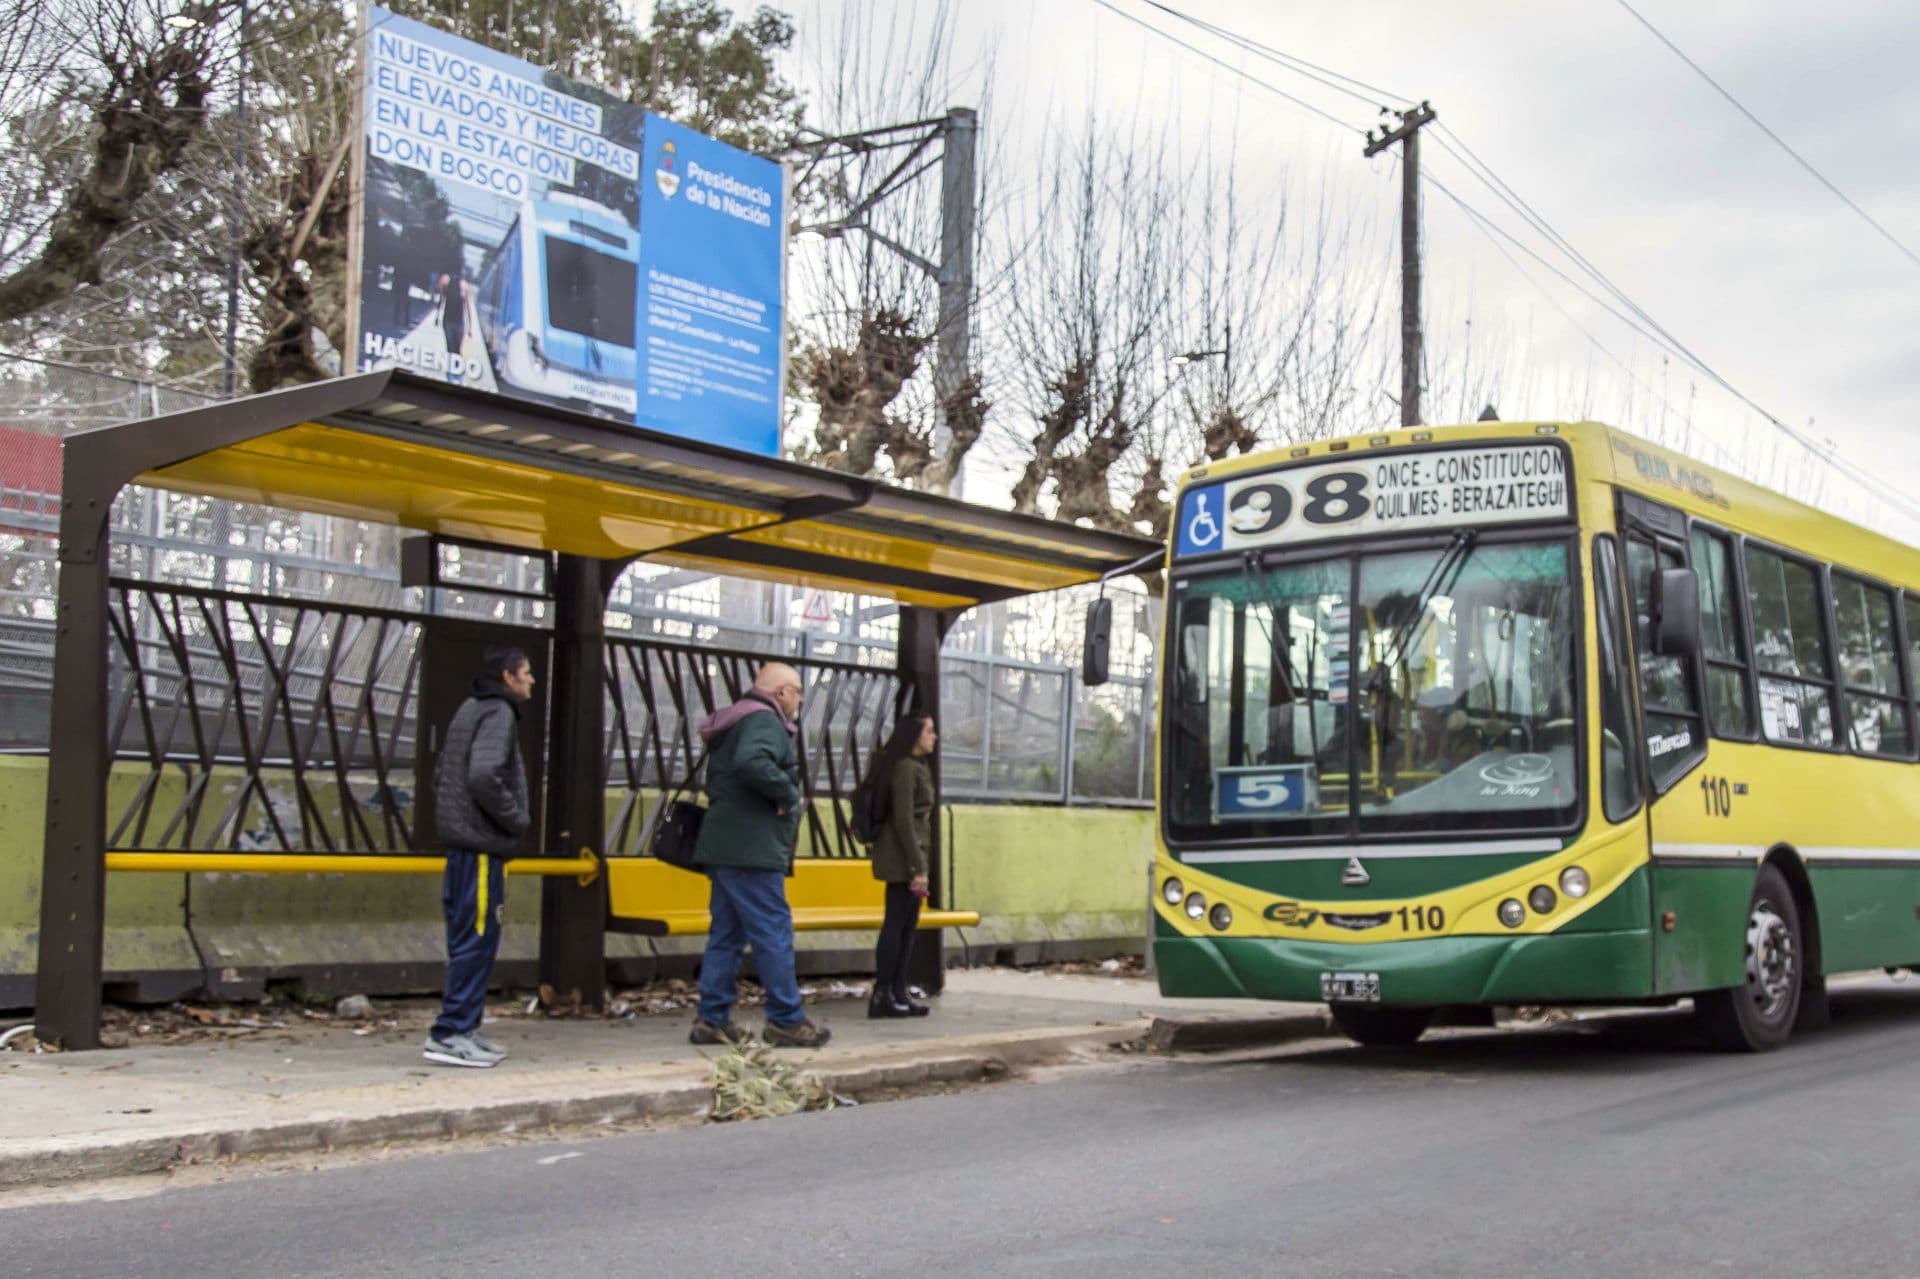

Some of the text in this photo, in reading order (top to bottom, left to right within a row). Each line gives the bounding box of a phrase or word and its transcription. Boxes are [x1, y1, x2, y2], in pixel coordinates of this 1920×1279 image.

[378, 33, 596, 129] NUEVOS ANDENES
[377, 98, 569, 181] EN LA ESTACION
[378, 65, 633, 174] ELEVADOS Y MEJORAS
[376, 131, 523, 195] DON BOSCO
[687, 160, 771, 208] Presidencia
[685, 184, 771, 228] de la Nación
[365, 332, 483, 380] HACIENDO
[1377, 461, 1420, 489] ONCE
[1436, 448, 1563, 483] CONSTITUCION
[1230, 472, 1370, 535] 98
[1376, 490, 1439, 519] QUILMES
[1452, 481, 1563, 513] BERAZATEGUI
[1236, 775, 1289, 808] 5
[1701, 775, 1730, 818] 110
[1397, 905, 1445, 932] 110
